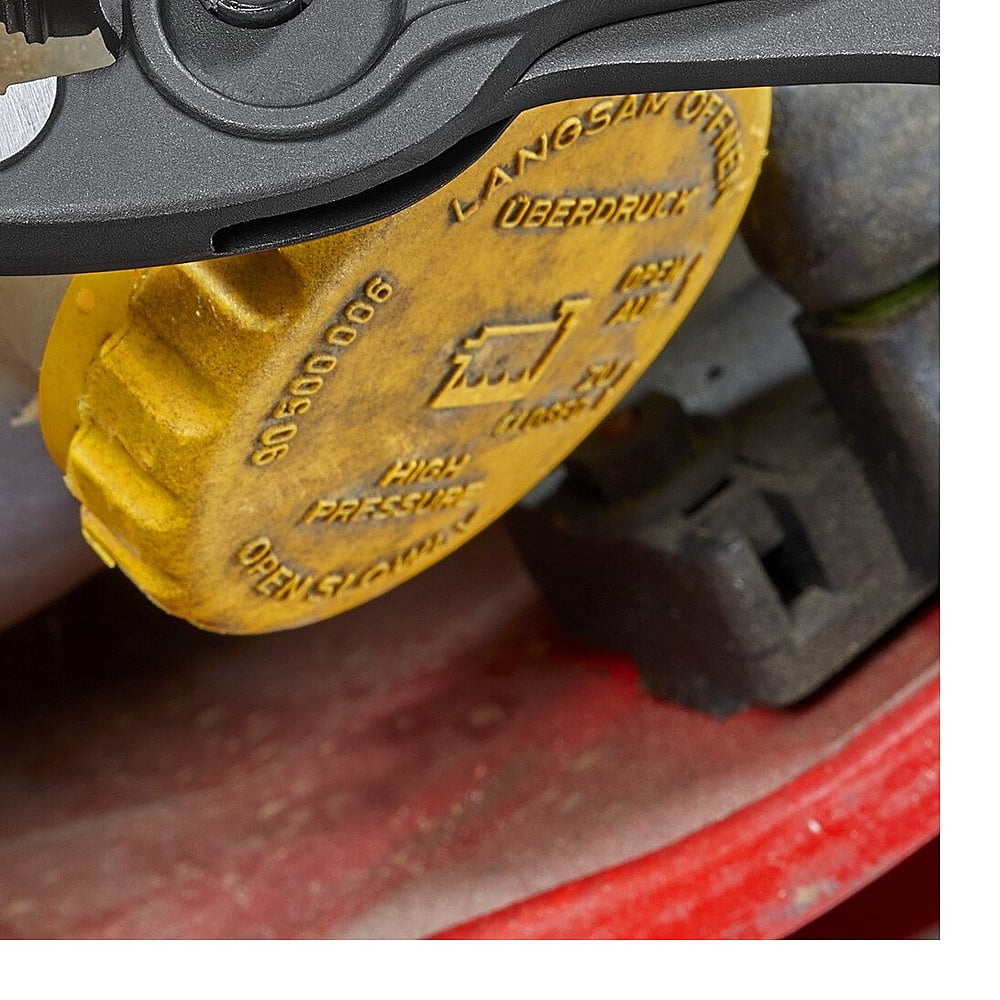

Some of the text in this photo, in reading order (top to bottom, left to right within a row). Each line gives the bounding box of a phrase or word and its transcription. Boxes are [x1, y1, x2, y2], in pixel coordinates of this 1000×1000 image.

[376, 453, 472, 487] HIGH
[298, 481, 484, 525] PRESSURE
[235, 536, 314, 602] OPEN
